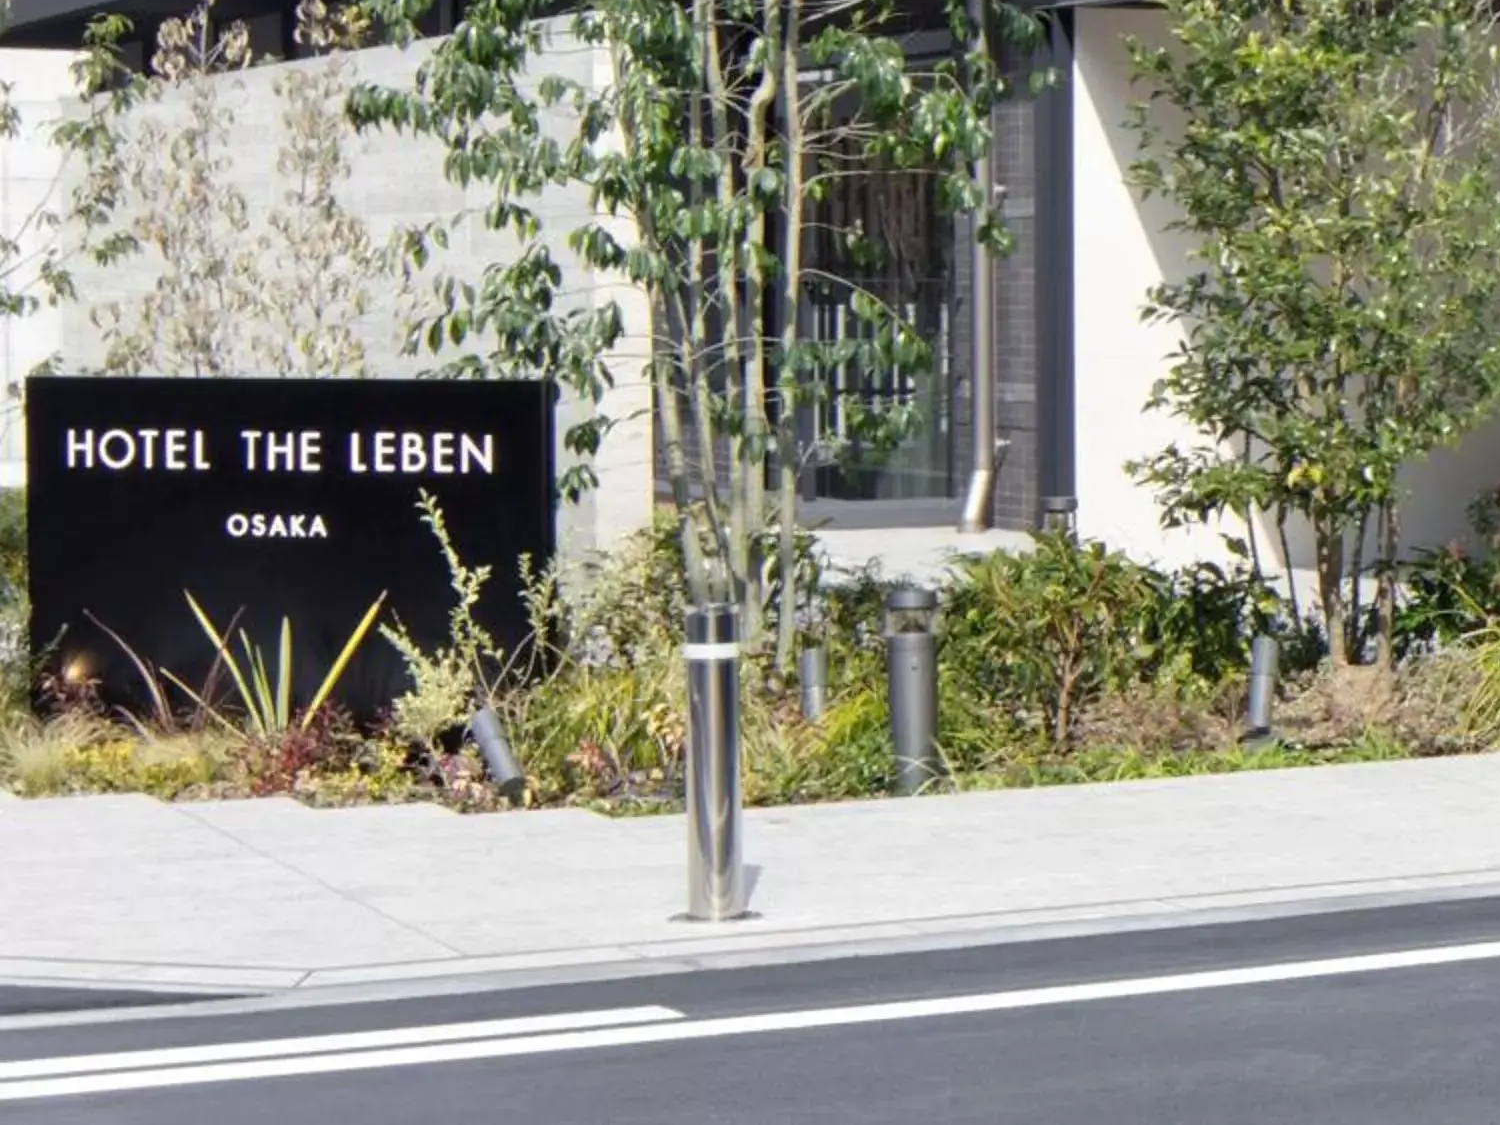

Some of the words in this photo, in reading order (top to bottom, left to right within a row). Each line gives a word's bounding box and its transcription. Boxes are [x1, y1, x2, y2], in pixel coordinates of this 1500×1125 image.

[66, 428, 211, 470] HOTEL
[240, 430, 322, 472] THE
[350, 431, 495, 474] LEBEN
[226, 512, 328, 538] OSAKA
